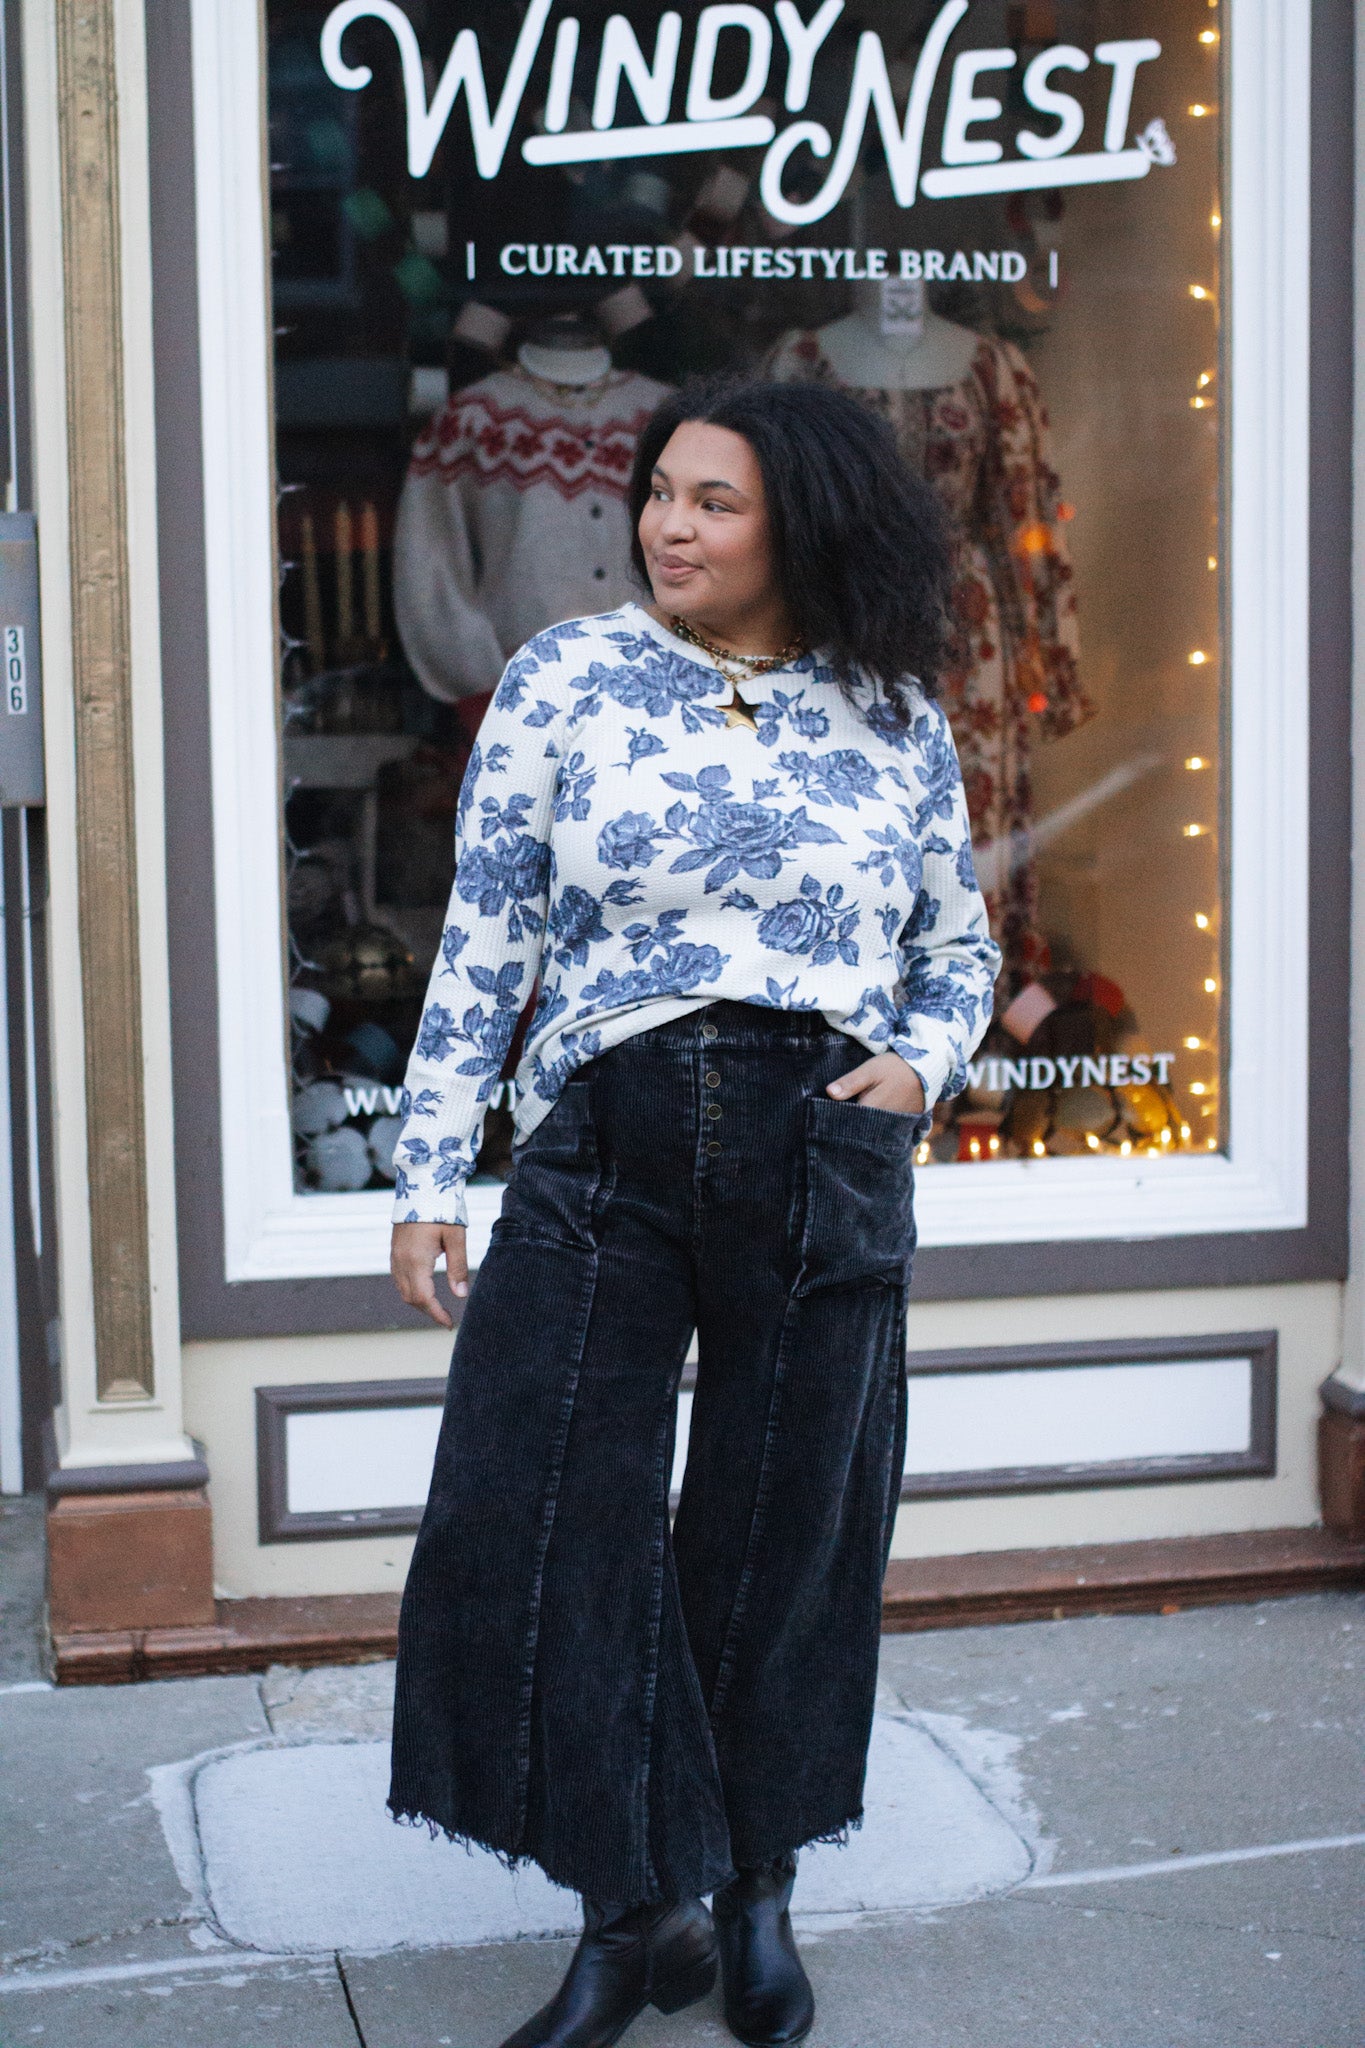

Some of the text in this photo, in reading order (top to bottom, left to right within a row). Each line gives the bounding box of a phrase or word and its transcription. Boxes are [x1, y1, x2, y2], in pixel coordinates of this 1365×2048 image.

[320, 0, 1162, 226] WINDY NEST
[499, 243, 1028, 282] CURATED LIFESTYLE BRAND
[8, 629, 22, 711] 306
